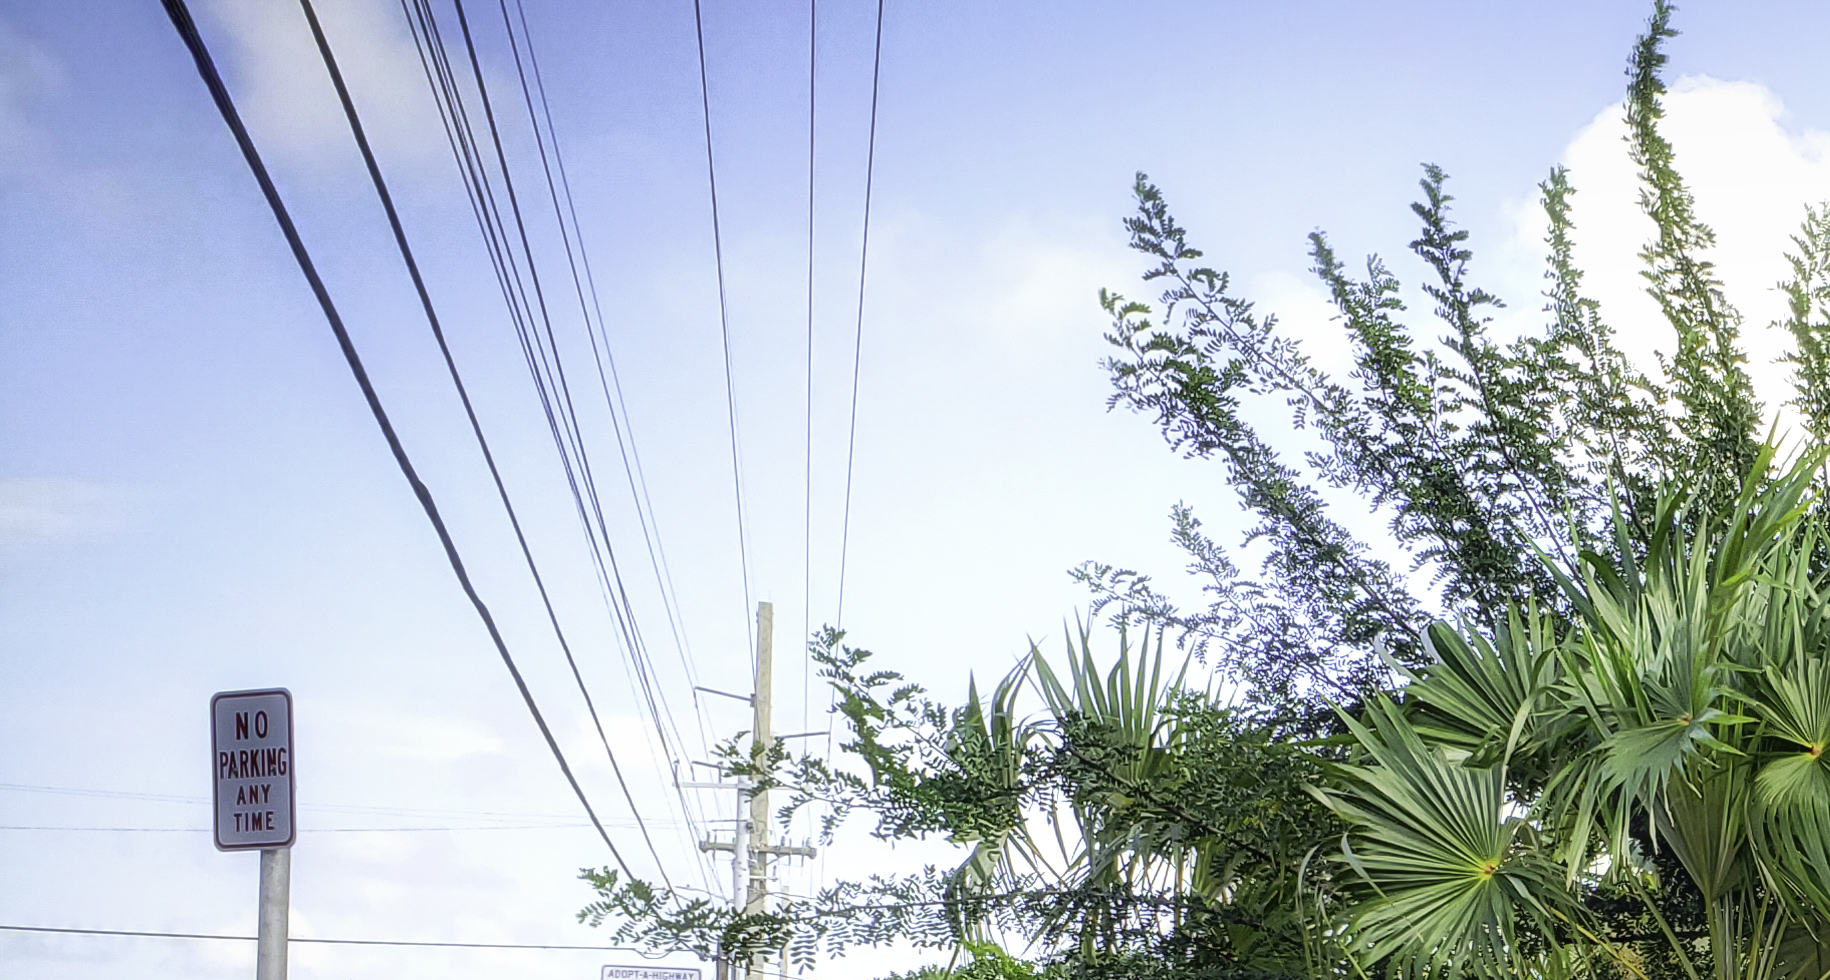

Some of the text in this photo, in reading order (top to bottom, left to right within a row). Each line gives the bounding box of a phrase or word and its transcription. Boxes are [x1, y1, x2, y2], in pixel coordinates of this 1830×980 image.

[235, 710, 268, 740] NO
[219, 747, 287, 780] PARKING
[236, 784, 271, 806] ANY
[233, 811, 275, 832] TIME
